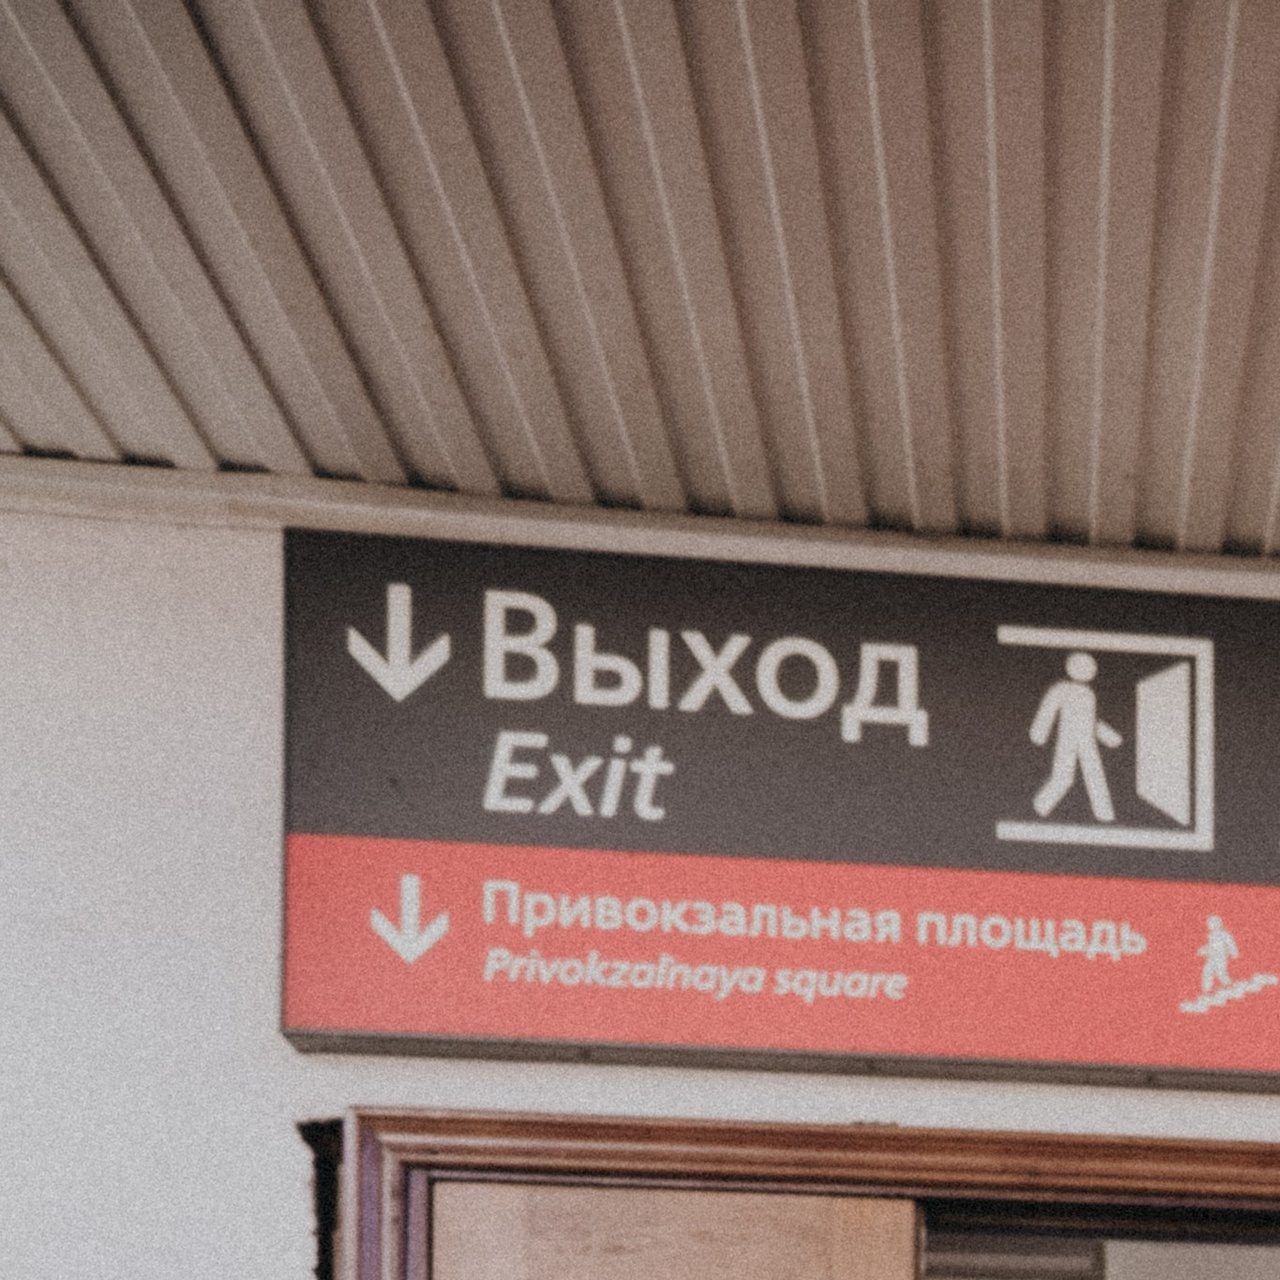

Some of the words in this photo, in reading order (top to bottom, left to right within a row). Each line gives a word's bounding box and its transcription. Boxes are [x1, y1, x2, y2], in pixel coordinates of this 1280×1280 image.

[483, 588, 932, 748] Выход
[482, 729, 676, 822] Exit
[482, 878, 902, 943] Привокзальная
[916, 910, 1148, 962] площадь
[774, 967, 909, 1005] square
